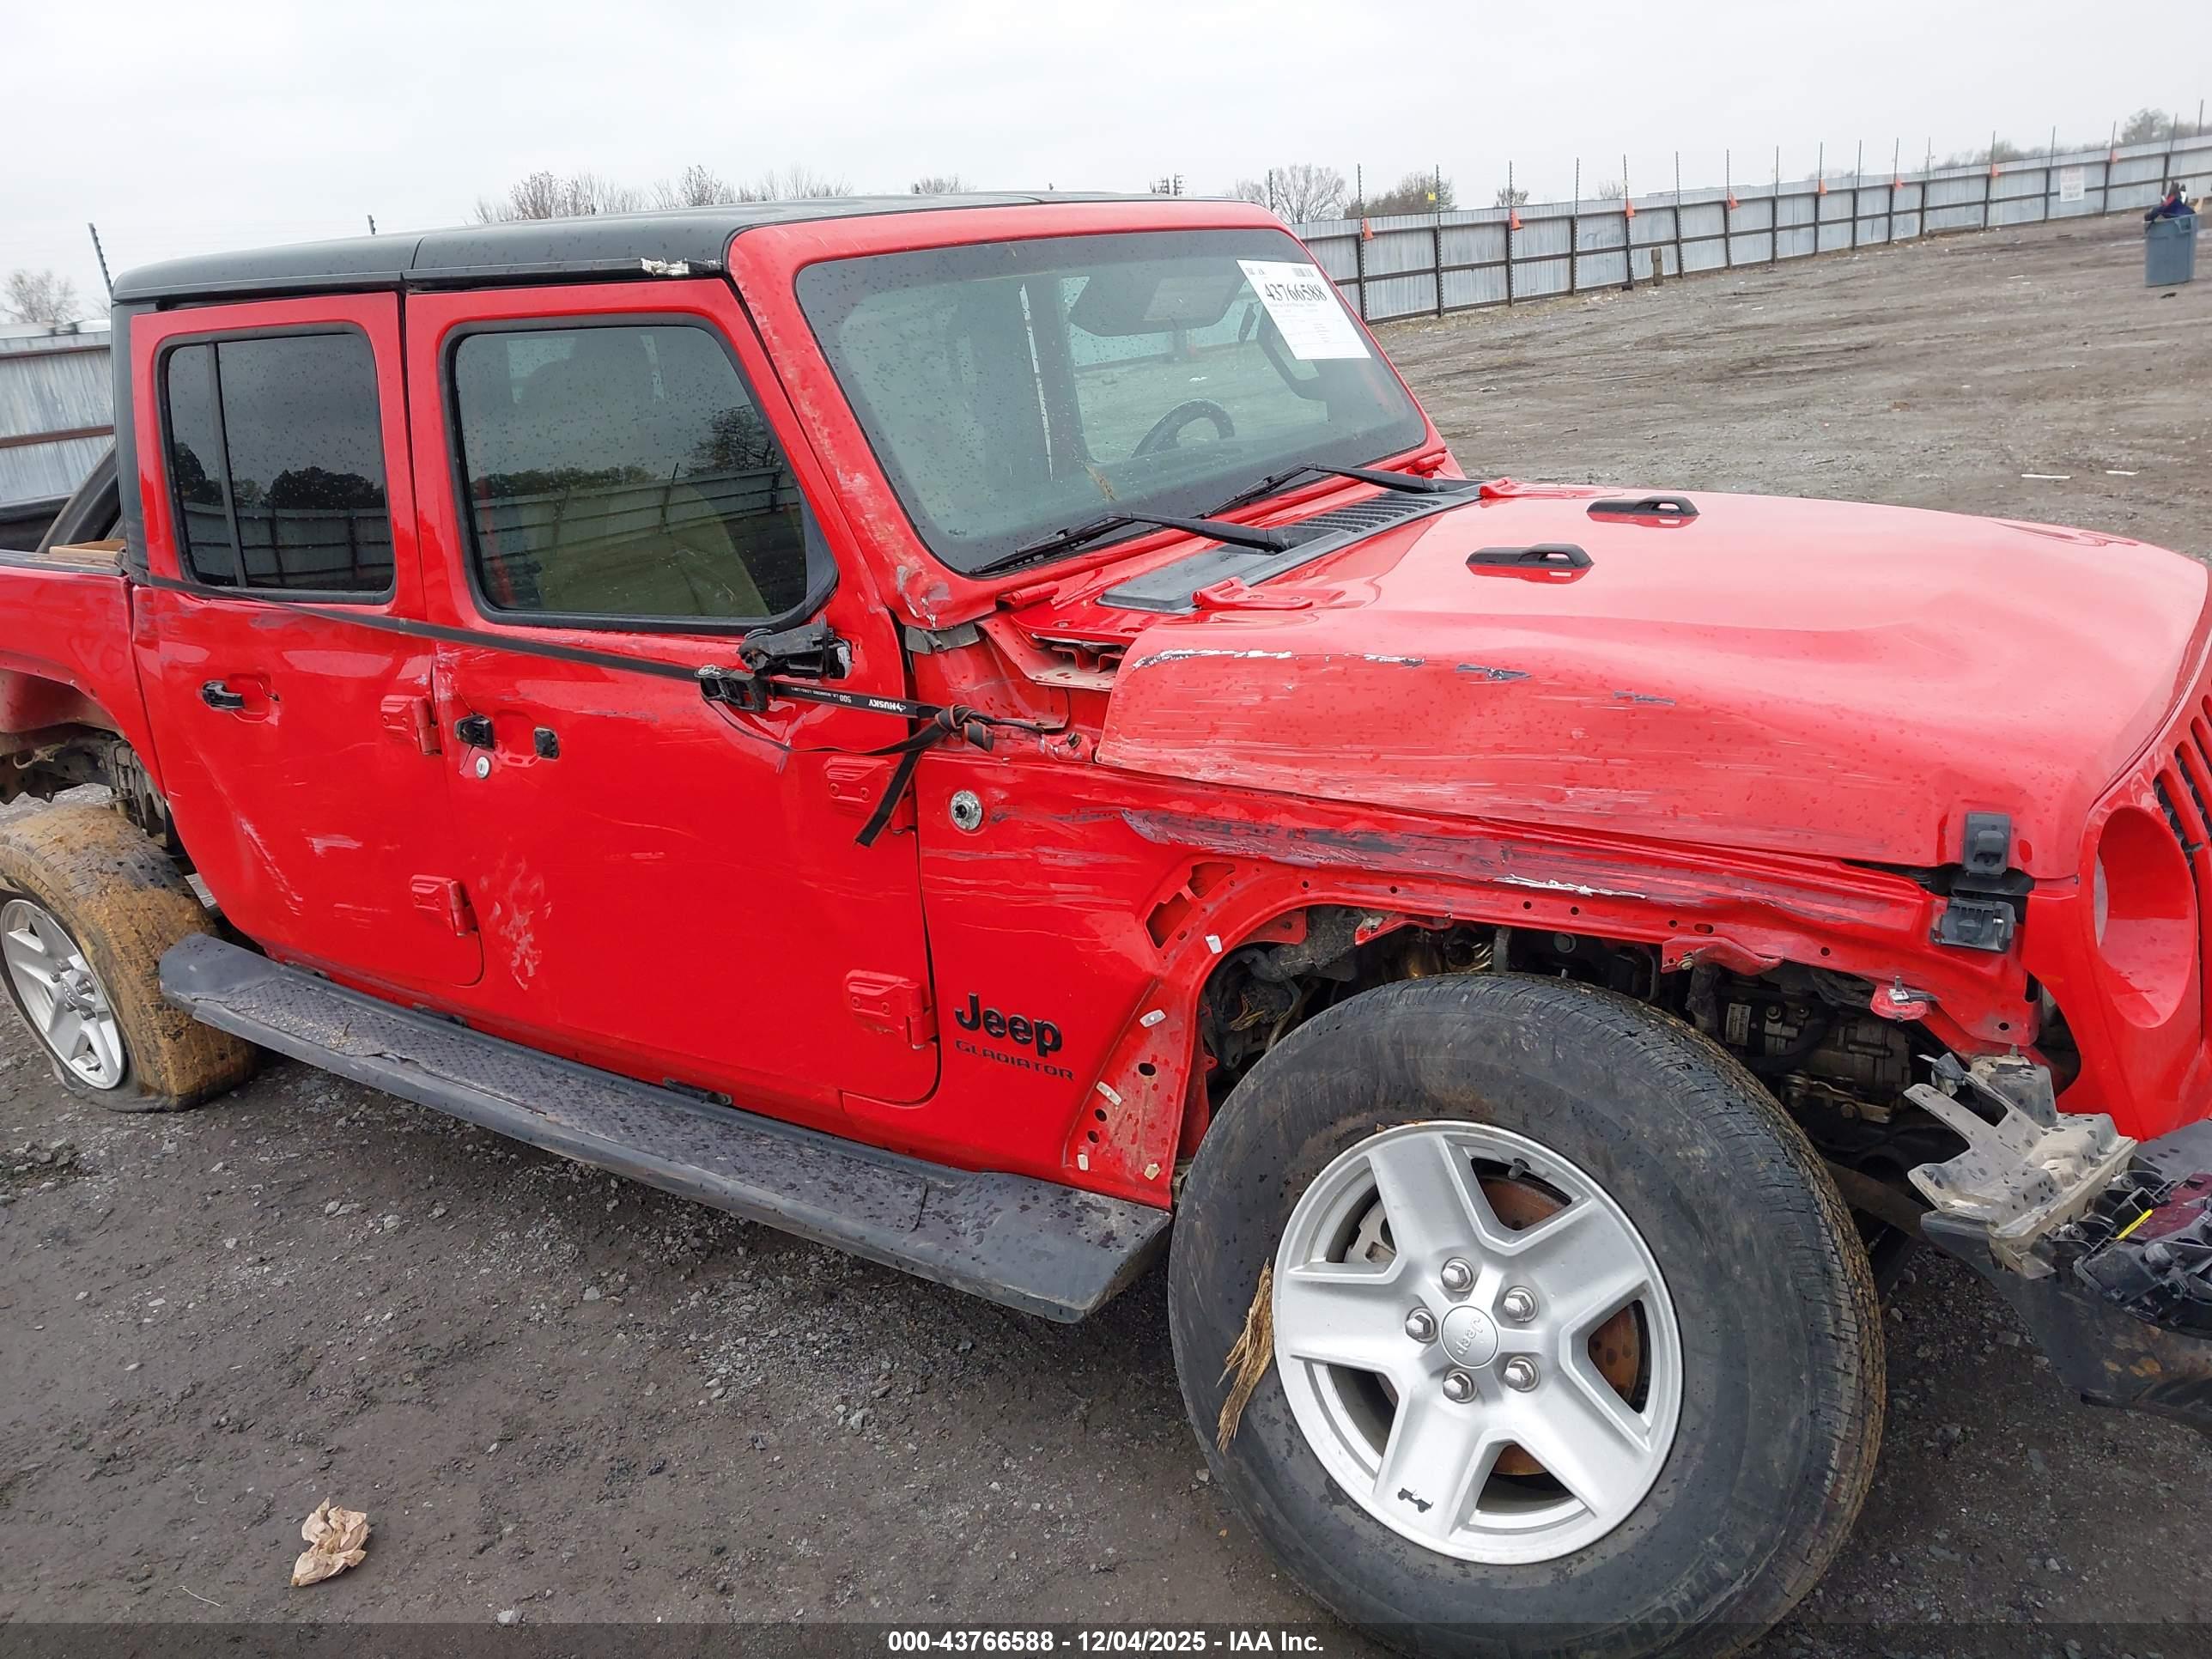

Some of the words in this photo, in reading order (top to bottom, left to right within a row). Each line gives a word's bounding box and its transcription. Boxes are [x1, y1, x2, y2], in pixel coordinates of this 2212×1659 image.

[1264, 283, 1328, 301] 43766588
[839, 695, 852, 703] 500
[868, 698, 896, 710] HUSKY
[954, 991, 1063, 1058] Jeep
[955, 1040, 1074, 1081] GLADIATOR
[1456, 1318, 1483, 1357] Jeep
